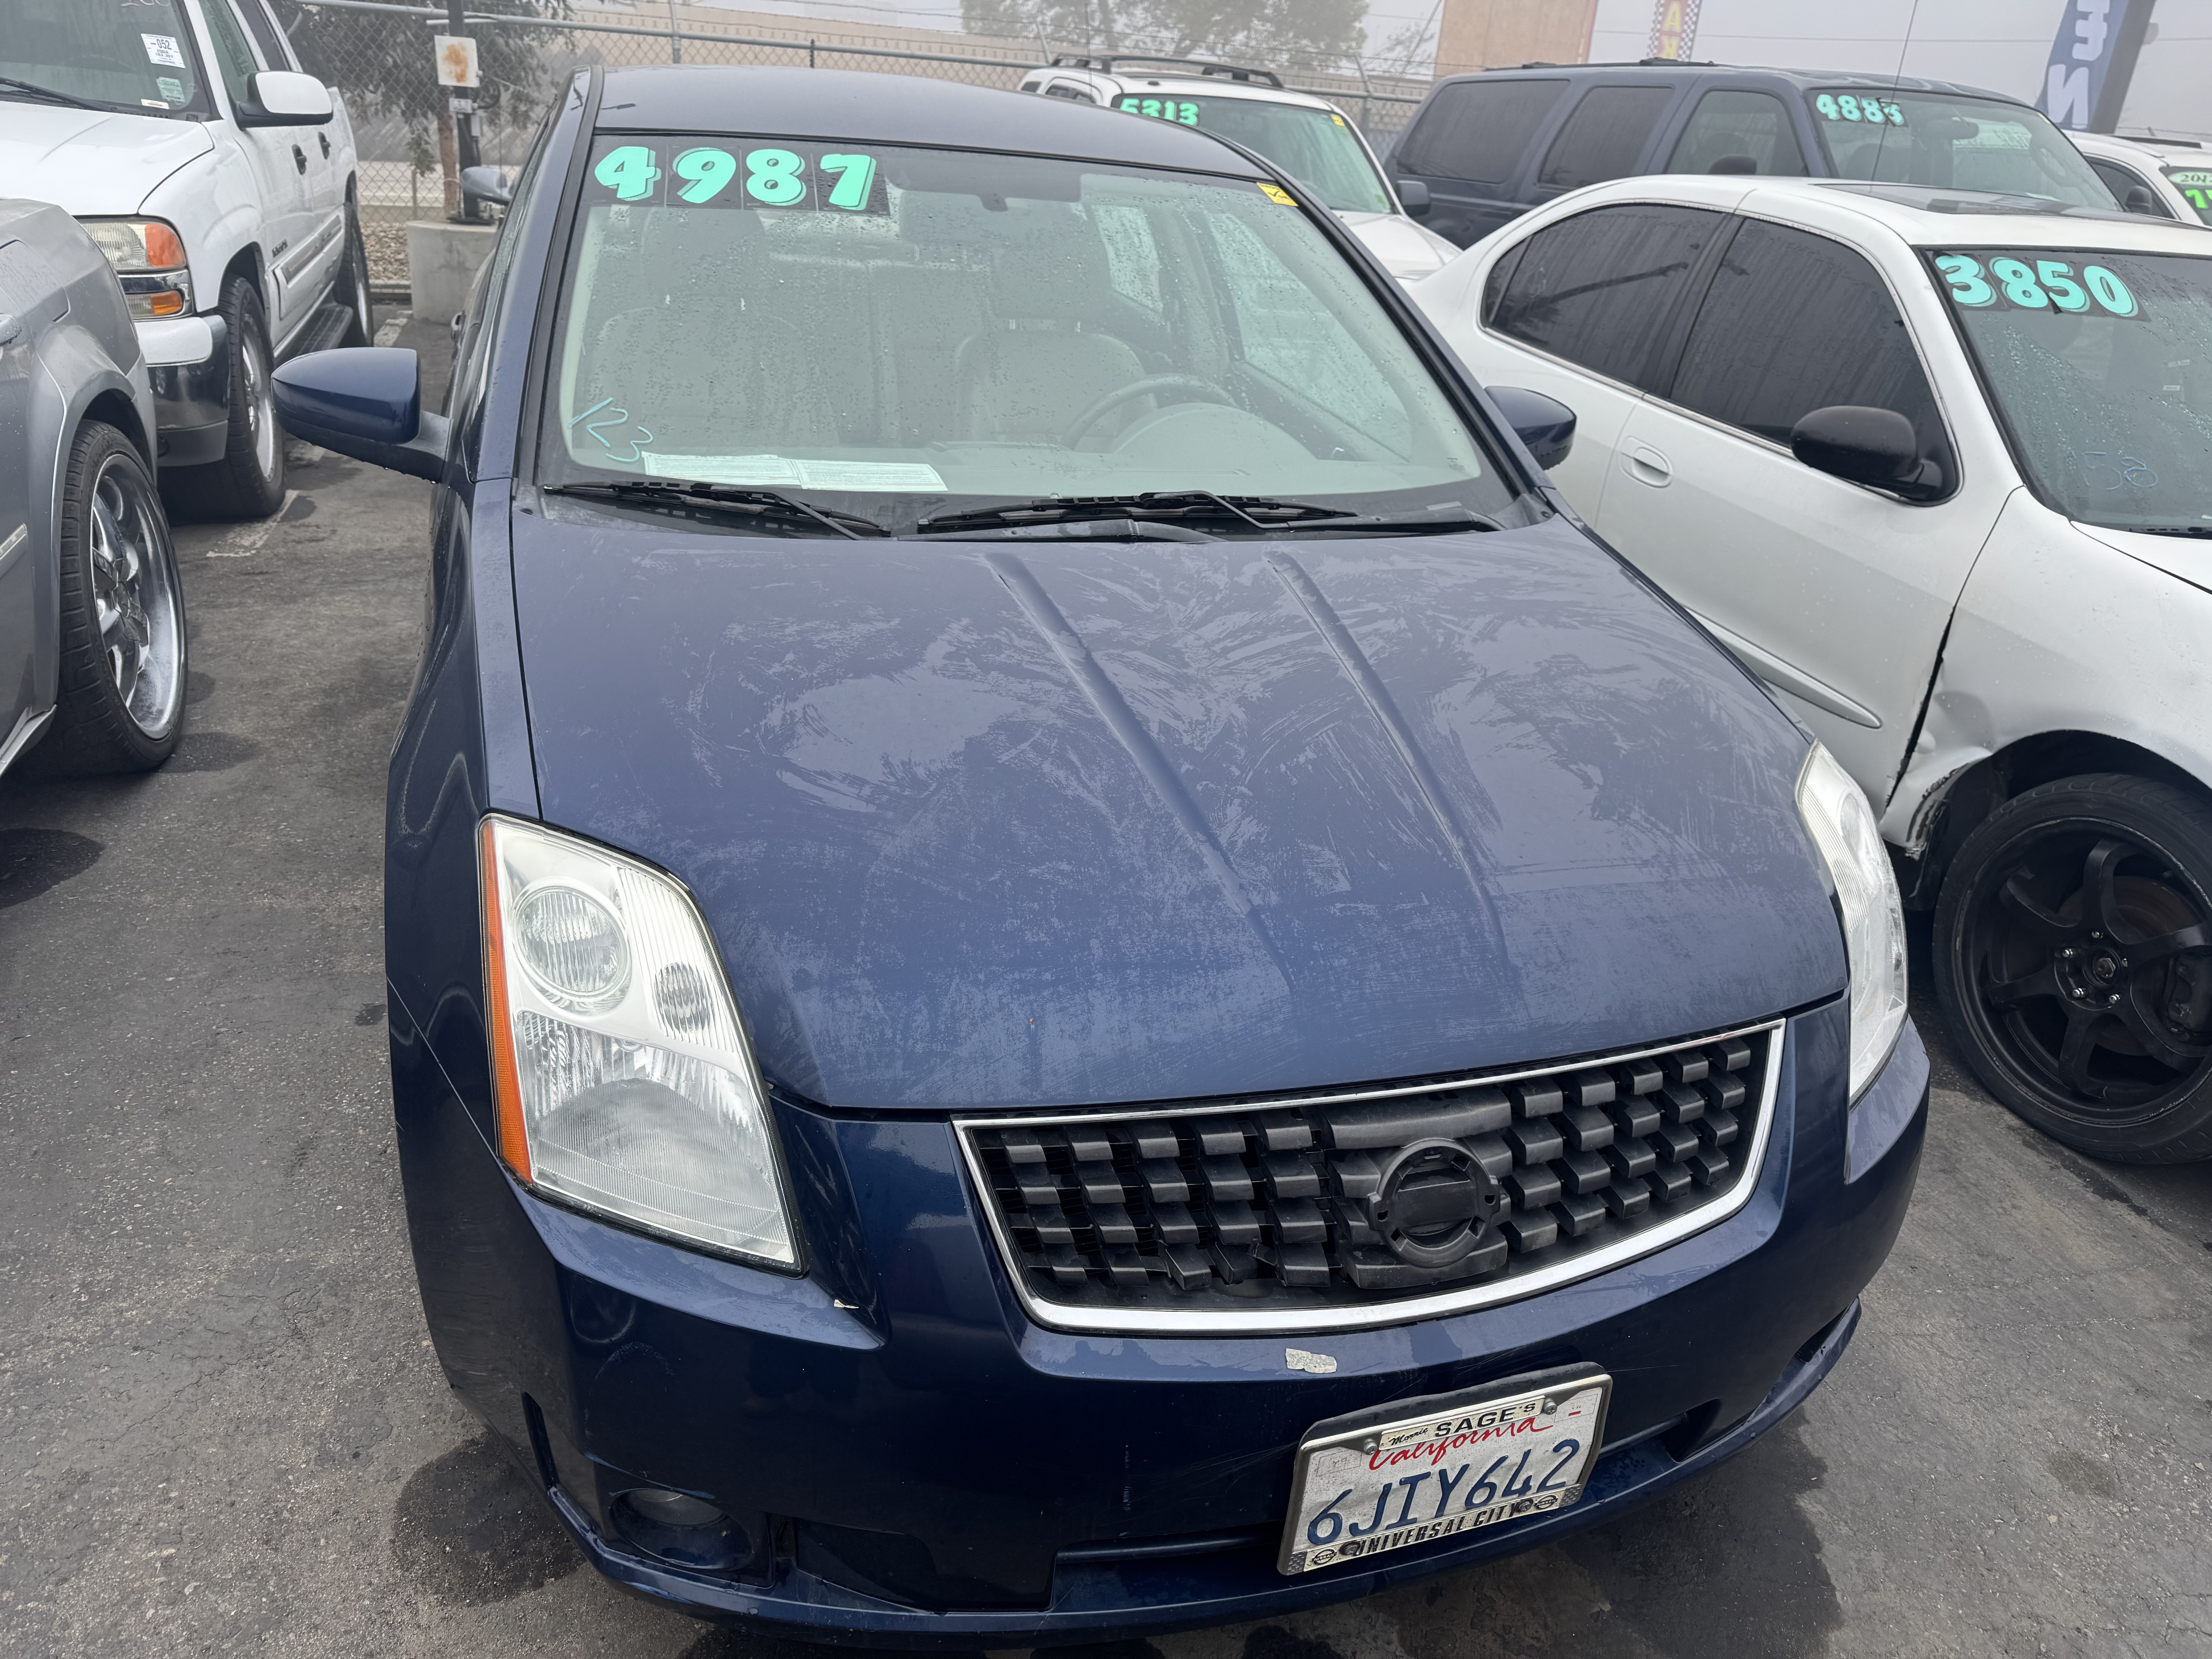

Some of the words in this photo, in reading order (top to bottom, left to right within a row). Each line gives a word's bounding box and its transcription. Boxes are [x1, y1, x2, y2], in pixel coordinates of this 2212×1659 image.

[1119, 98, 1200, 126] 5313
[594, 146, 877, 211] 4987
[1935, 254, 2138, 317] 3850
[567, 397, 653, 462] 123
[1369, 1417, 1553, 1470] California
[1388, 1427, 1429, 1446] Morrie
